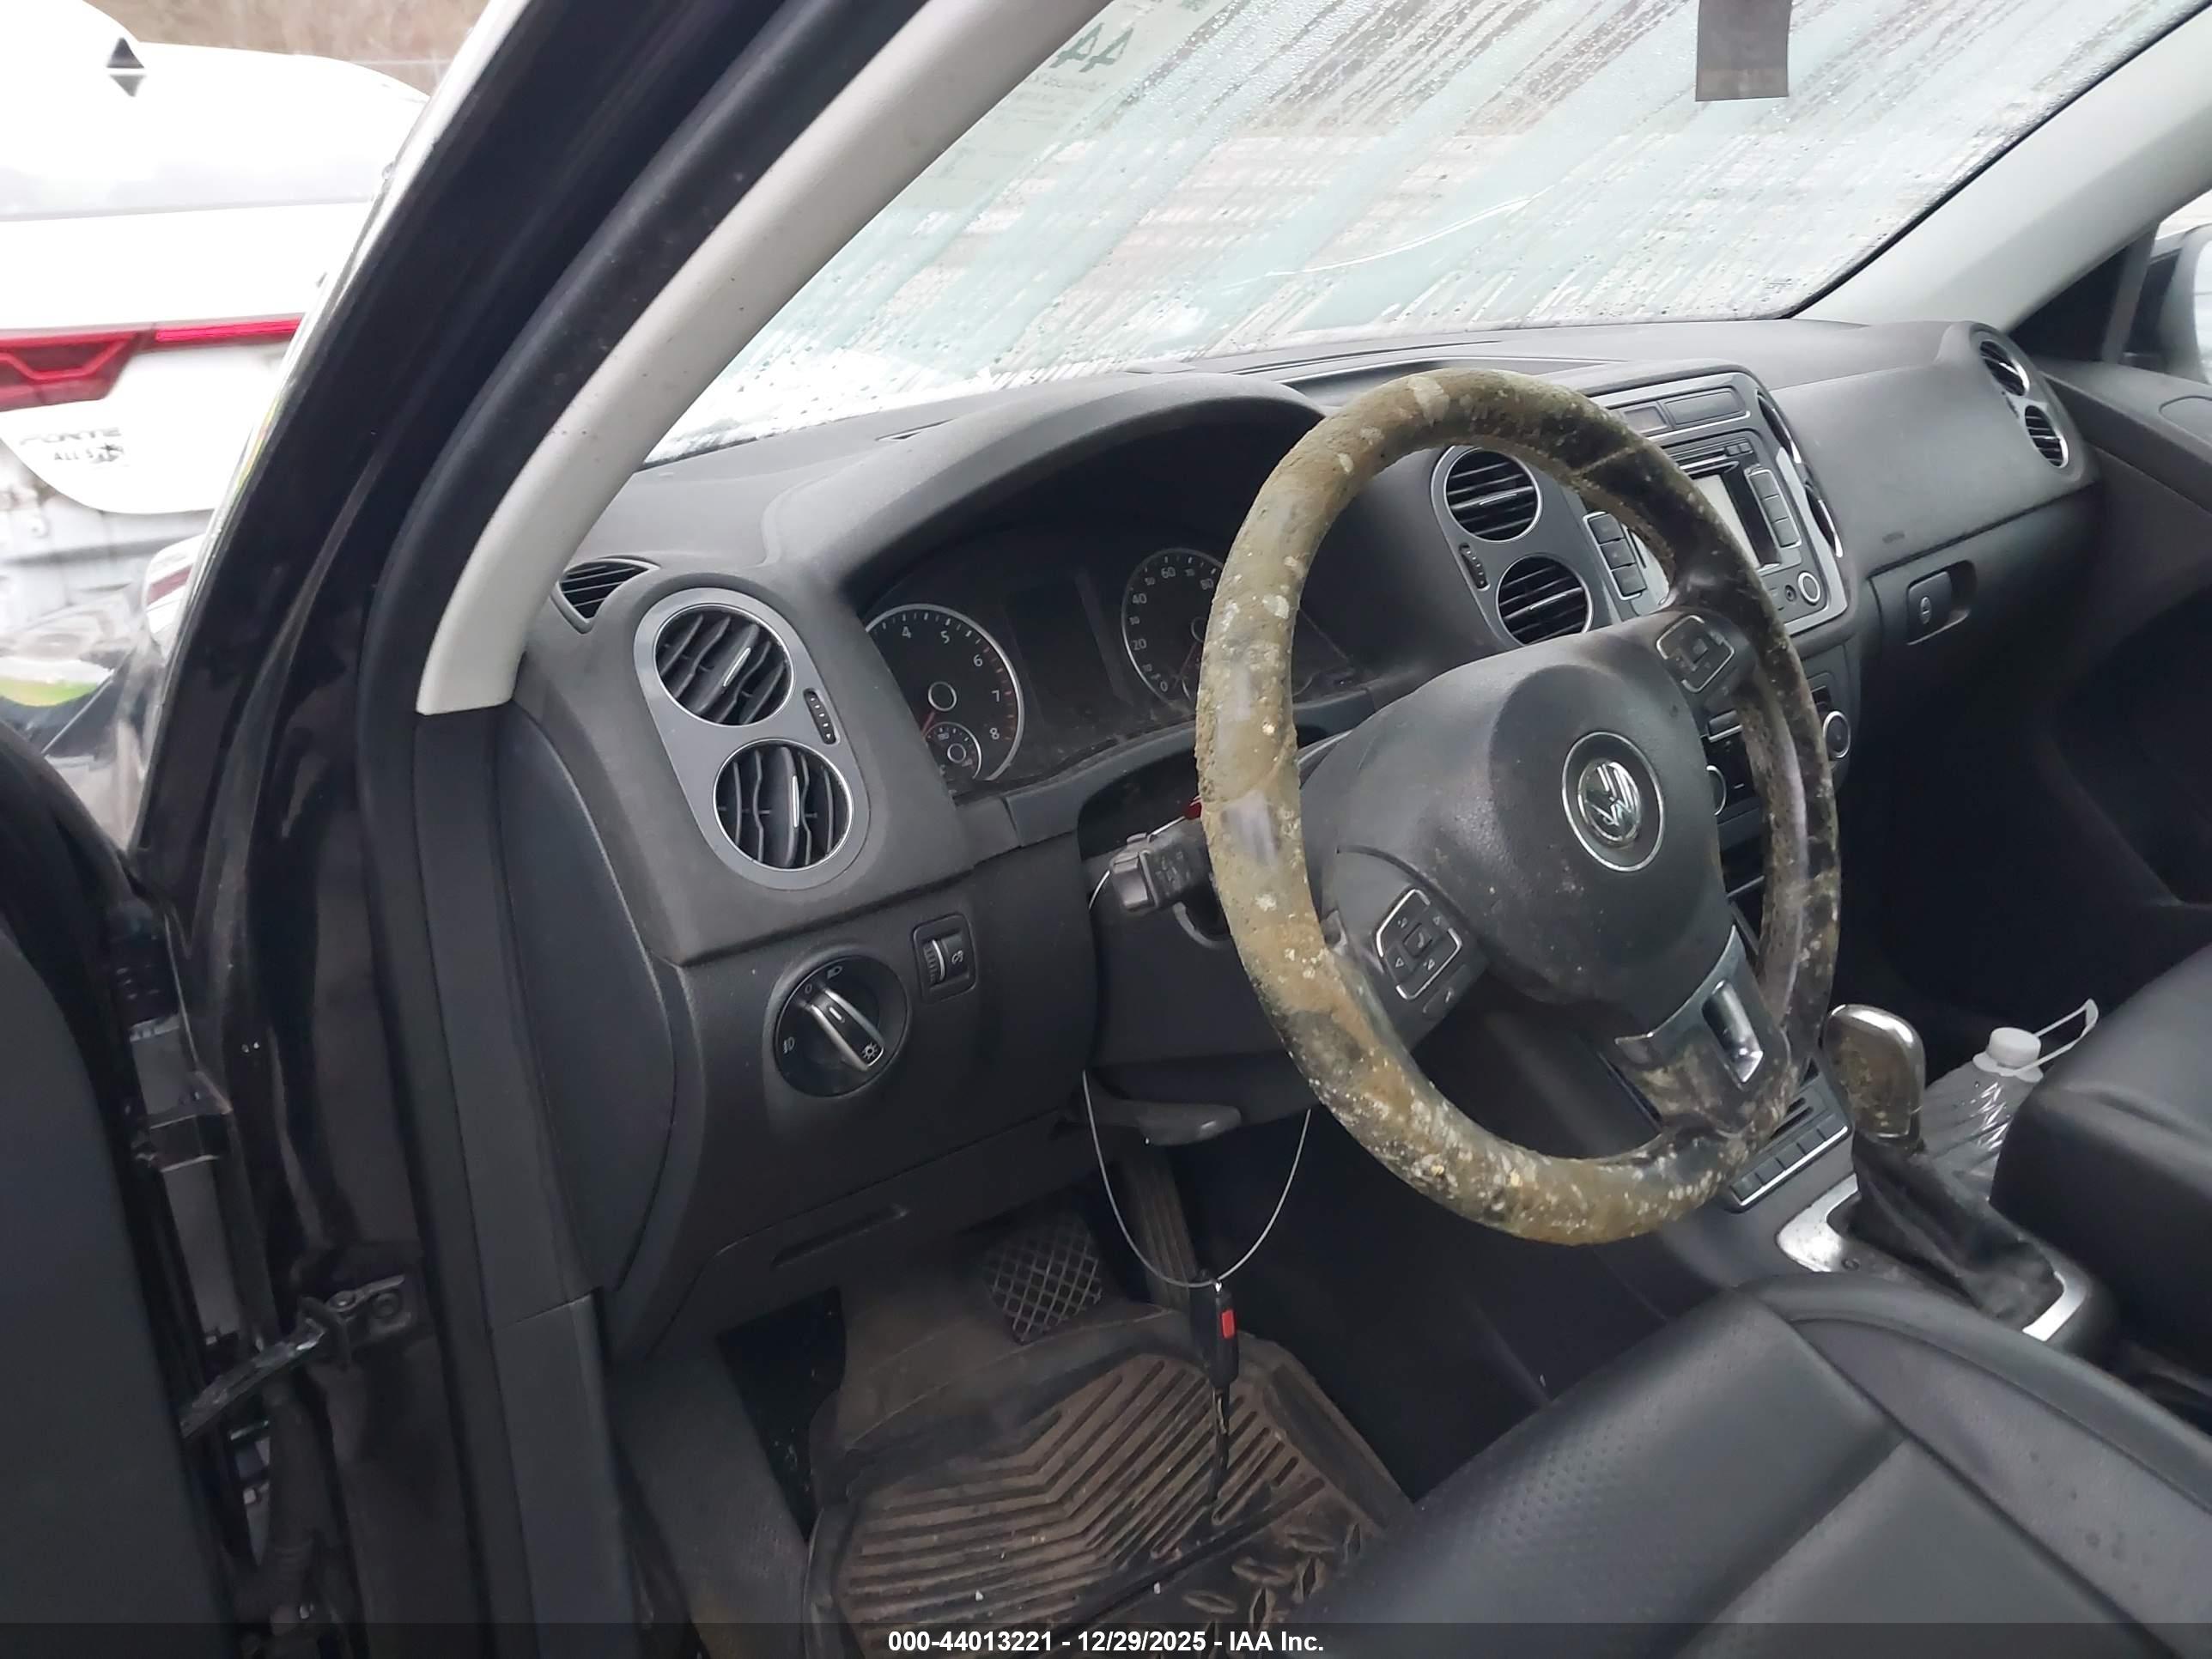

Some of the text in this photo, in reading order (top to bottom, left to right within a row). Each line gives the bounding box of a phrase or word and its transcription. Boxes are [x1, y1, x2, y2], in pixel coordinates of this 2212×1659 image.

[1161, 566, 1176, 579] 60
[1132, 592, 1147, 605] 40
[902, 626, 912, 638] 4
[940, 630, 950, 644] 5
[1132, 638, 1147, 651] 20
[973, 653, 983, 667] 6
[1160, 681, 1169, 692] 0
[991, 690, 1000, 702] 7
[989, 727, 1000, 740] 8
